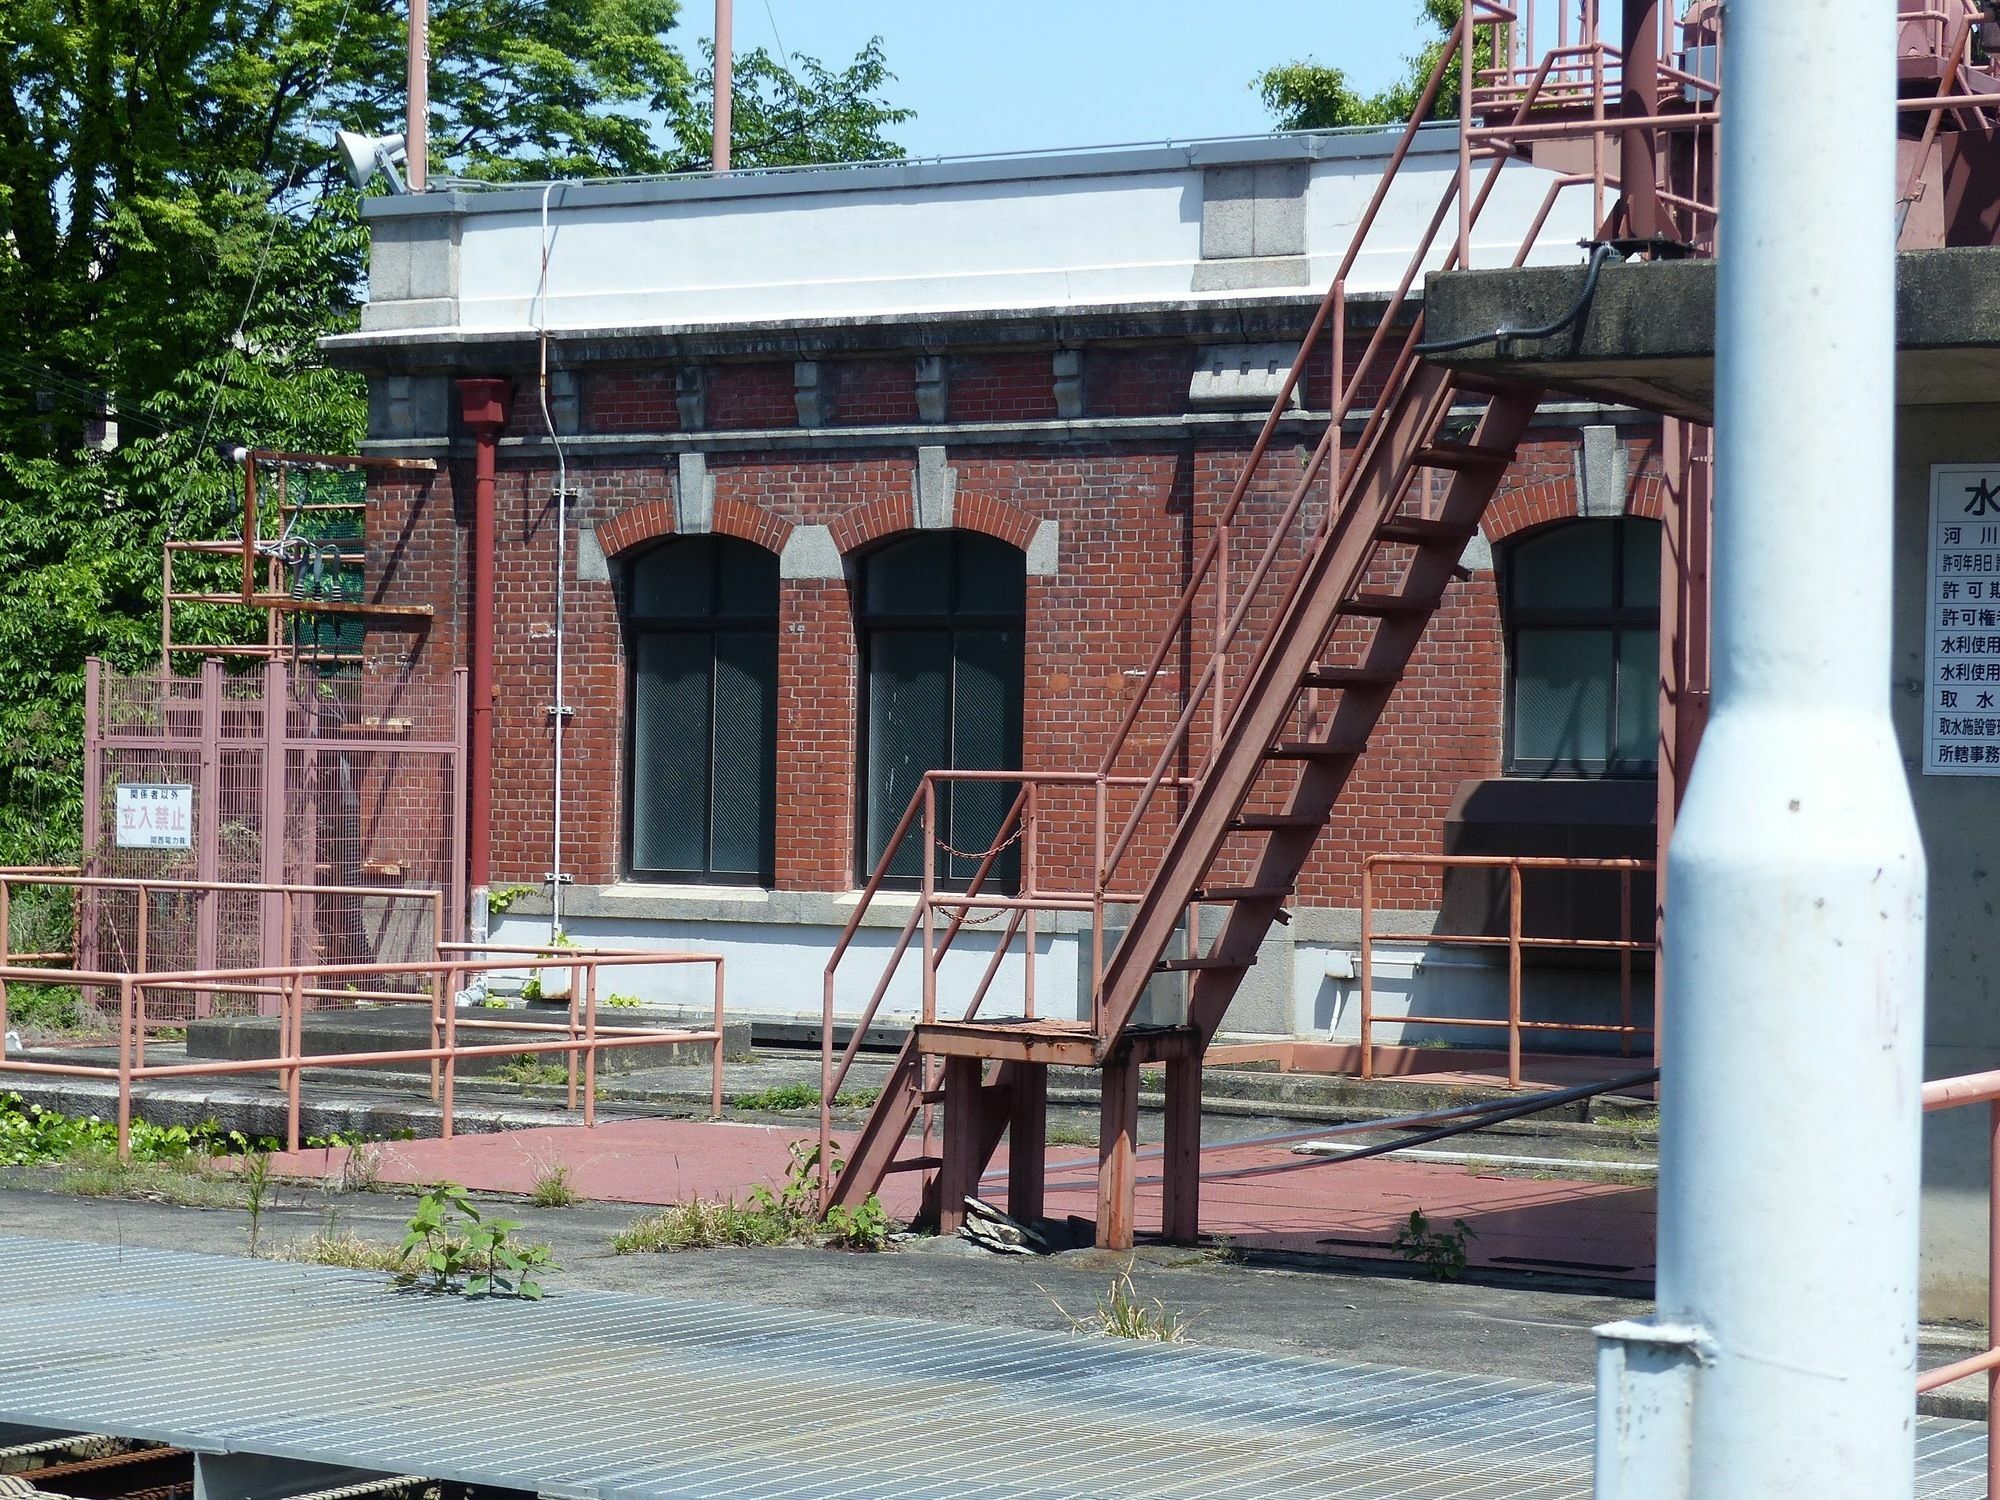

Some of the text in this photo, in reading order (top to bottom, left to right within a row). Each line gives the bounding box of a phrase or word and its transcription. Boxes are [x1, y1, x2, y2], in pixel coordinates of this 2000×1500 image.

[1964, 478, 2000, 516] 水
[1943, 554, 1992, 572] 許可年月日
[1942, 608, 2000, 626] 許可権
[1941, 636, 2000, 653] 水利使用
[1941, 663, 2000, 681] 水利使用
[1938, 745, 2000, 763] 所轄事務
[130, 789, 178, 800] 関係者以外
[122, 805, 185, 831] 立入禁止
